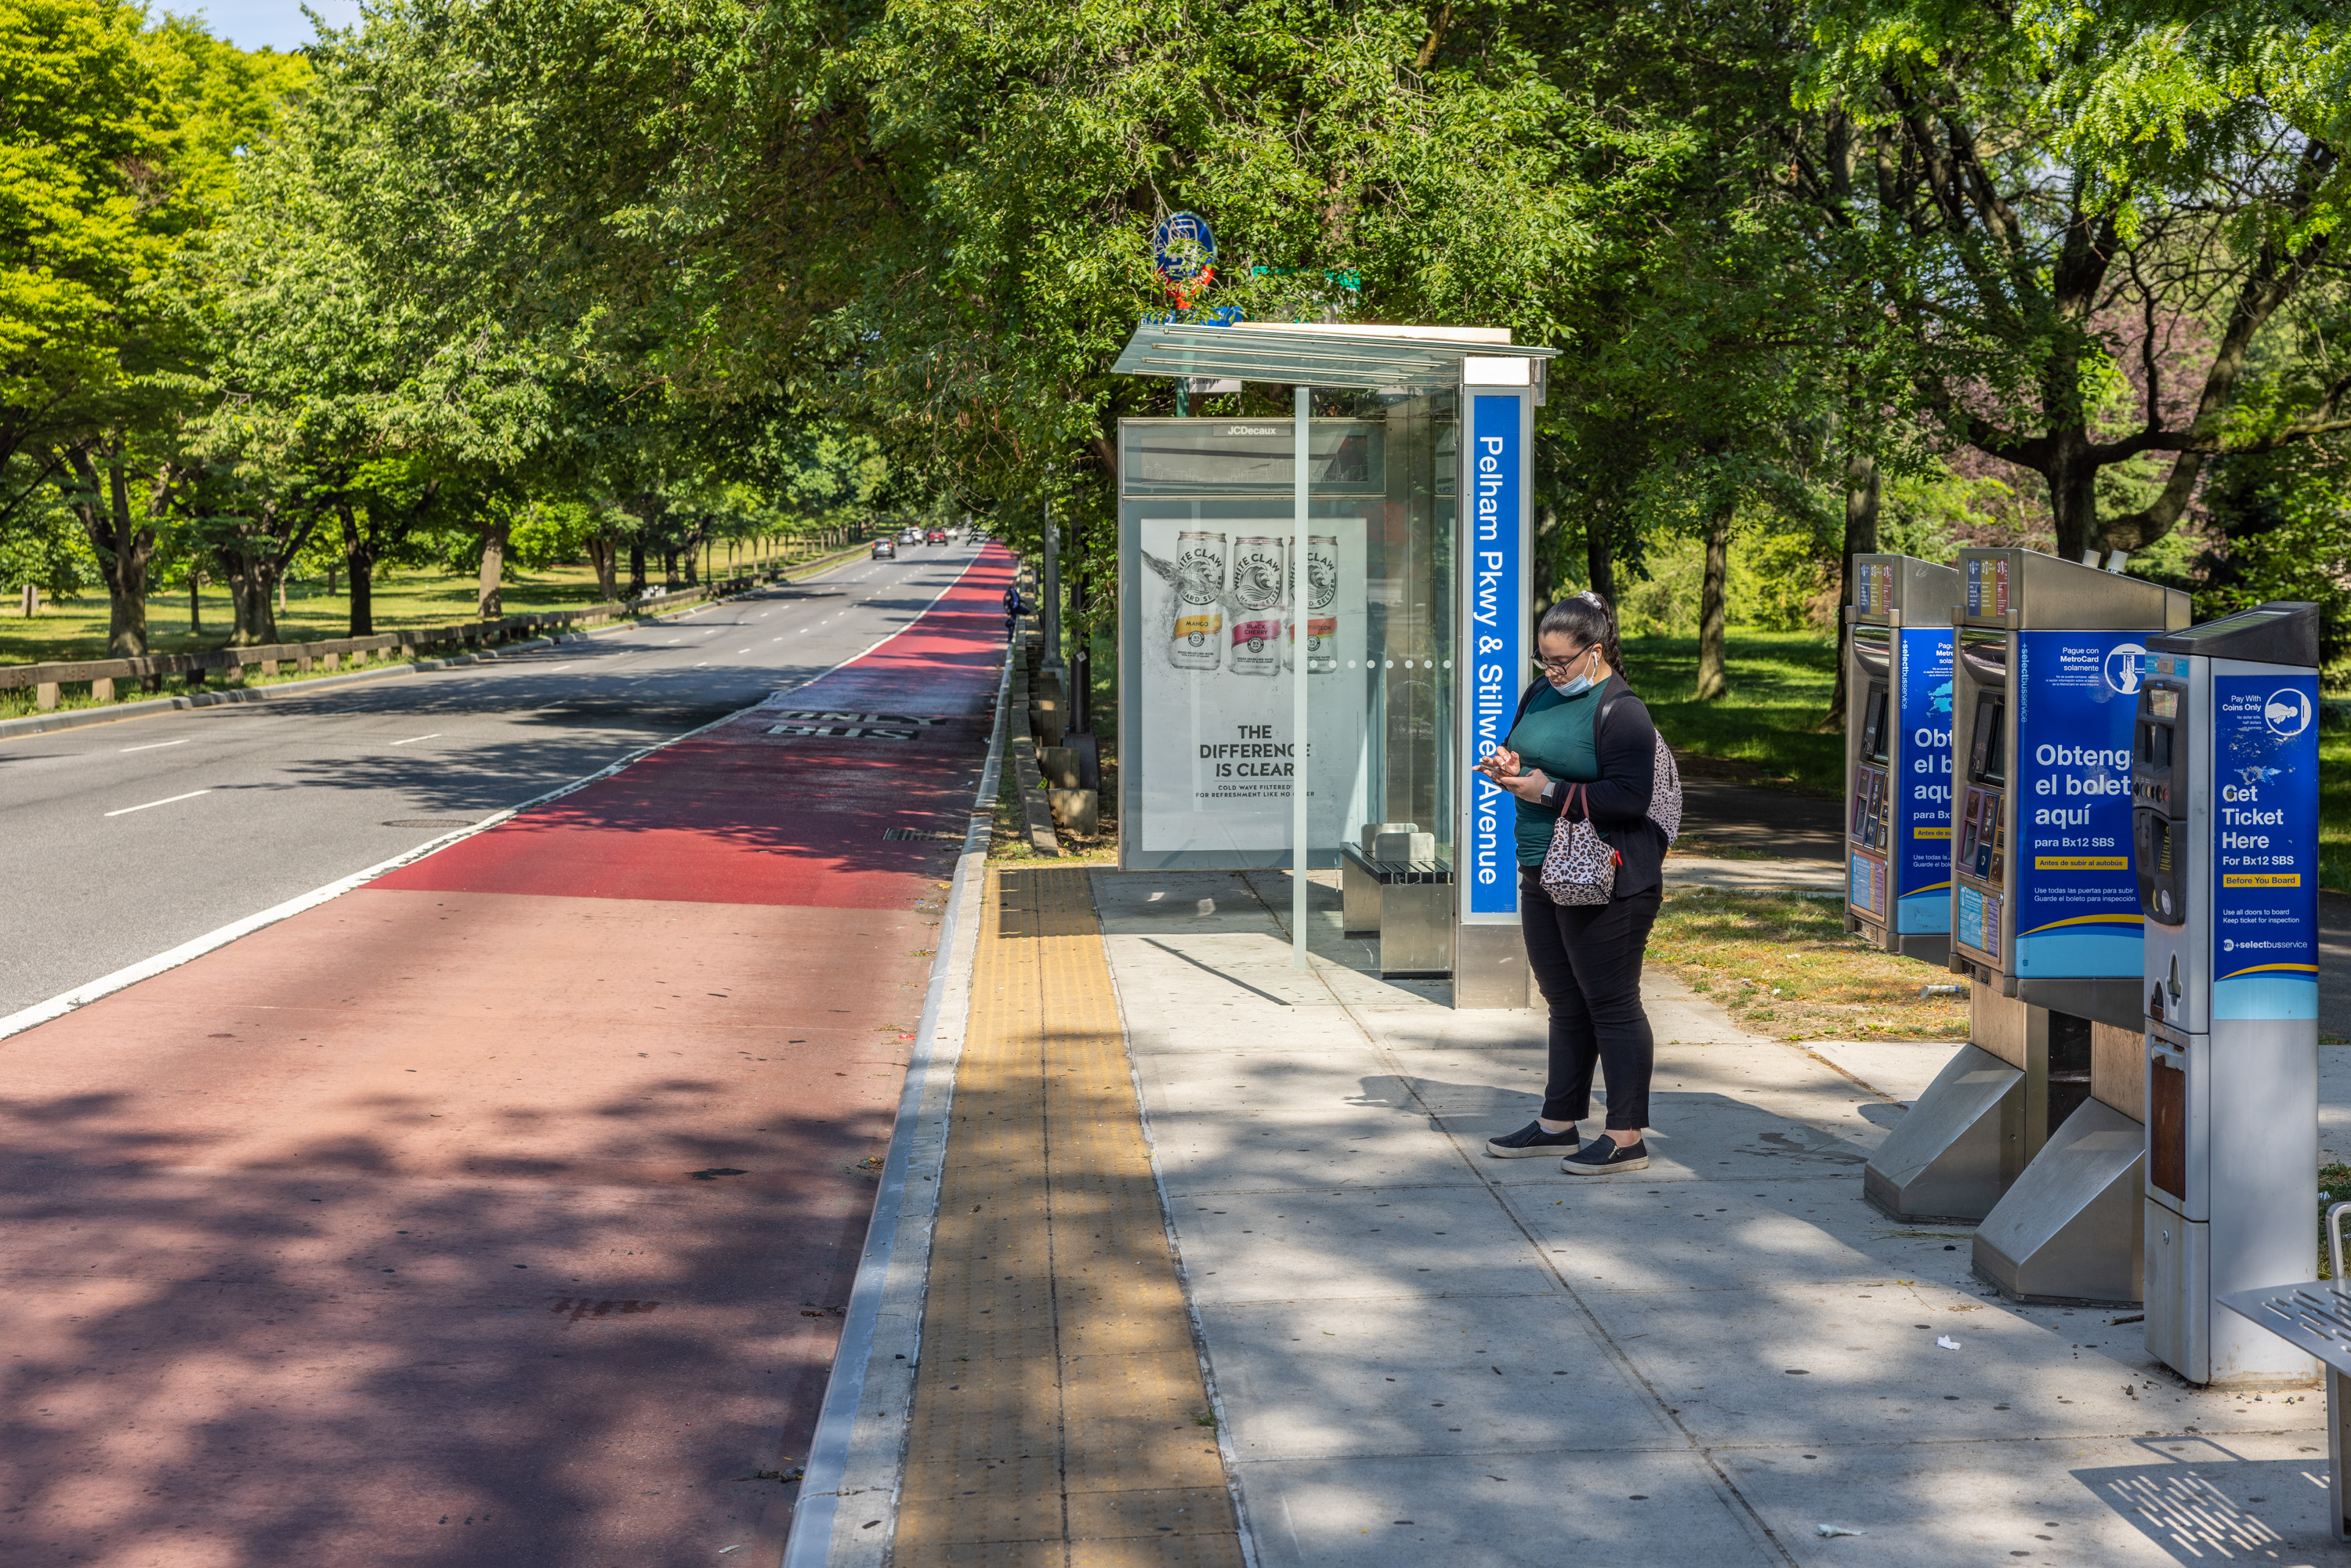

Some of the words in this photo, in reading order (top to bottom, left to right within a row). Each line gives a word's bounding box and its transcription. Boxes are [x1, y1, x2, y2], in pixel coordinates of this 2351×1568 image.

[1228, 426, 1276, 435] JCDecaux
[1480, 436, 1503, 541] Pelham
[1194, 549, 1223, 567] CLAW
[1308, 552, 1335, 570] CLAW
[1234, 556, 1250, 590] WHITE
[1252, 553, 1281, 573] CLAW
[1317, 579, 1335, 605] SELTZER
[1473, 551, 1503, 627] Pkwy
[1479, 636, 1503, 656] &
[2231, 695, 2244, 704] Pay
[1479, 664, 1503, 762] Stillwe
[1237, 725, 1272, 739] THE
[1914, 728, 1952, 747] Obt
[1914, 755, 1933, 773] el
[2036, 744, 2133, 771] Obteng
[1216, 763, 1232, 777] IS
[1237, 763, 1295, 777] CLEAR
[2035, 774, 2057, 795] el
[2066, 774, 2132, 795] bolet
[2222, 784, 2259, 802] Get
[1914, 784, 1951, 804] aqu
[1914, 812, 1935, 820] para
[1938, 810, 1951, 819] Bx
[2035, 803, 2092, 829] aquí
[2222, 808, 2284, 825] Ticket
[1478, 780, 1502, 885] Avenue
[2222, 831, 2269, 849] Here
[2034, 839, 2059, 849] para
[2063, 838, 2089, 847] Bx12
[2092, 838, 2114, 847] SBS
[2222, 856, 2241, 865] For
[2243, 856, 2269, 865] Bx12
[2272, 856, 2295, 865] SBS
